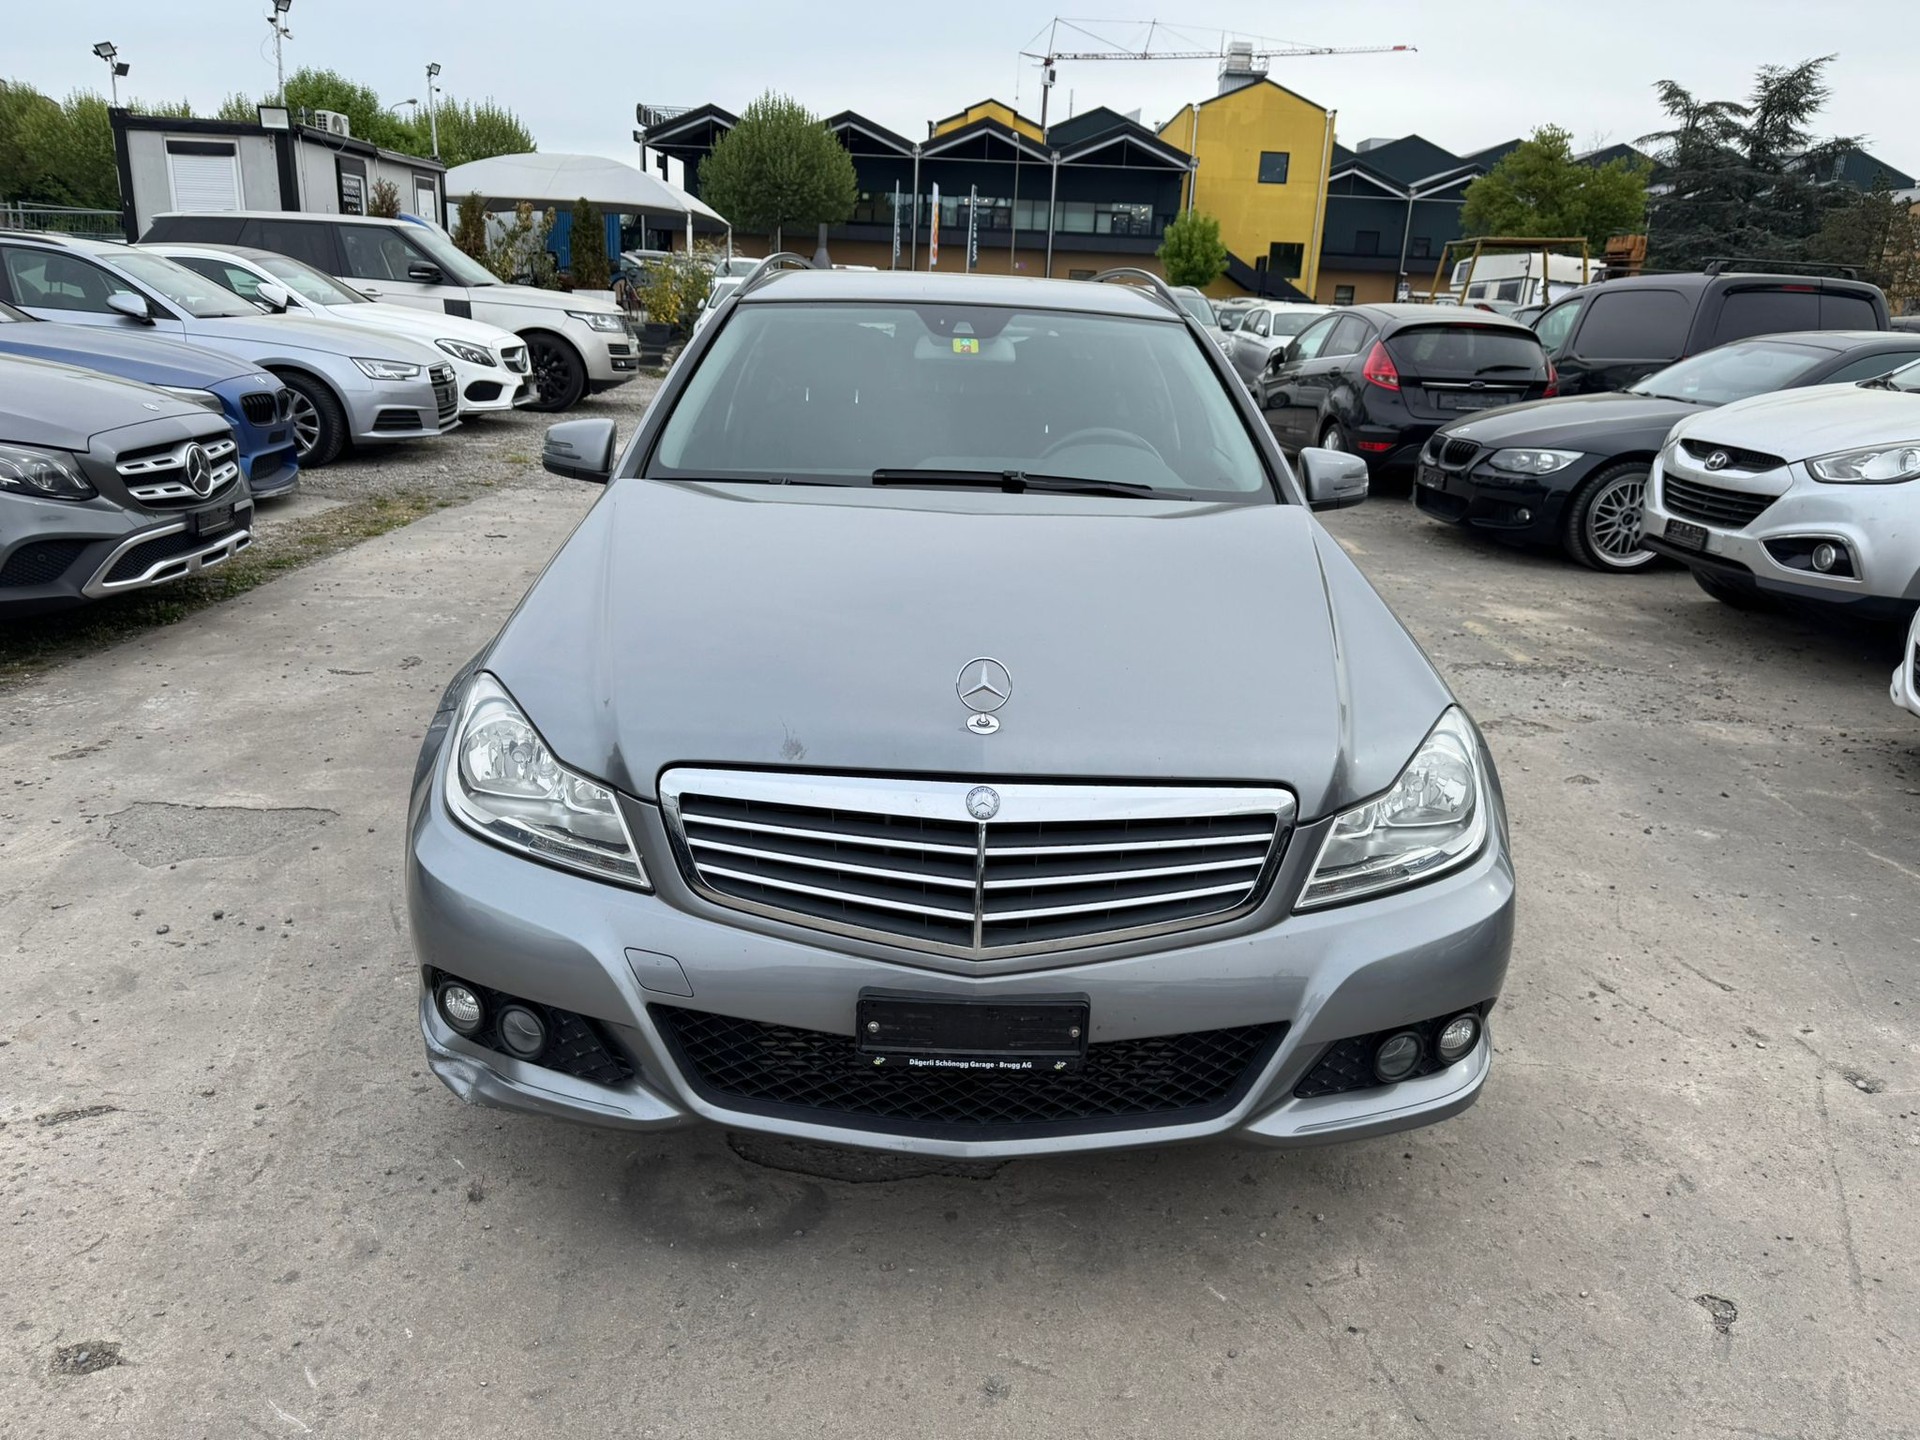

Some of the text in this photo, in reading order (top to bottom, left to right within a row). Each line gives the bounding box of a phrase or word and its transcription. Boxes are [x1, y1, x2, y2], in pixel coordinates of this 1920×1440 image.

[970, 1061, 995, 1070] Garage
[999, 1061, 1021, 1070] Brugg
[1021, 1061, 1032, 1069] AG
